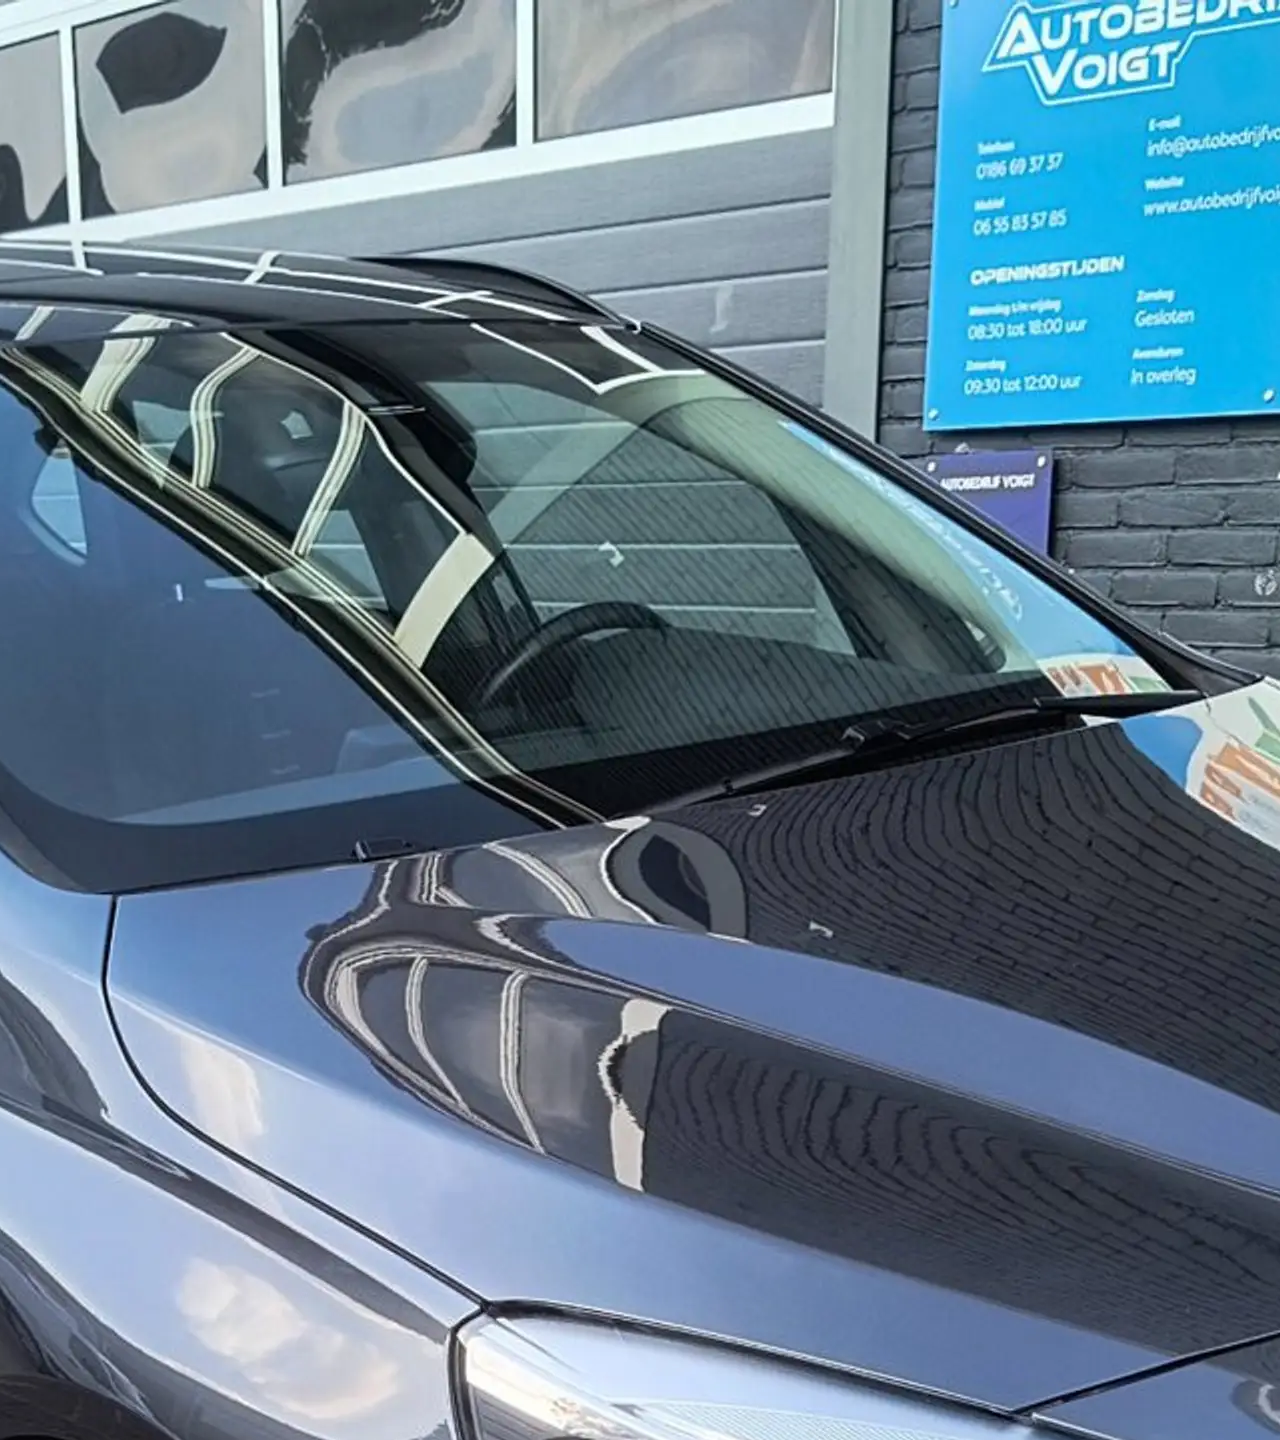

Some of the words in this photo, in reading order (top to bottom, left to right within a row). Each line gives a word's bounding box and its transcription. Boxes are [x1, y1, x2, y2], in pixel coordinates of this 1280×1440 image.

[1034, 40, 1180, 96] VOIGT
[976, 160, 1007, 180] 0186
[1029, 154, 1045, 173] 37
[1047, 152, 1063, 172] 37
[974, 218, 992, 236] 06
[993, 216, 1009, 234] 55
[1030, 211, 1047, 230] 57
[970, 255, 1125, 286] OPENINGSTIJDEN
[968, 321, 1005, 340] 08:30
[1007, 320, 1025, 336] tot
[1028, 317, 1062, 335] 18:00
[1065, 318, 1087, 333] uur
[1134, 308, 1195, 328] Gesloten
[964, 377, 1001, 395] 09:30
[1003, 377, 1020, 392] tot
[1024, 374, 1058, 390] 12:00
[1060, 375, 1082, 389] uur
[1131, 368, 1144, 386] In
[1146, 365, 1196, 386] overleg
[1002, 473, 1035, 488] VOIGT
